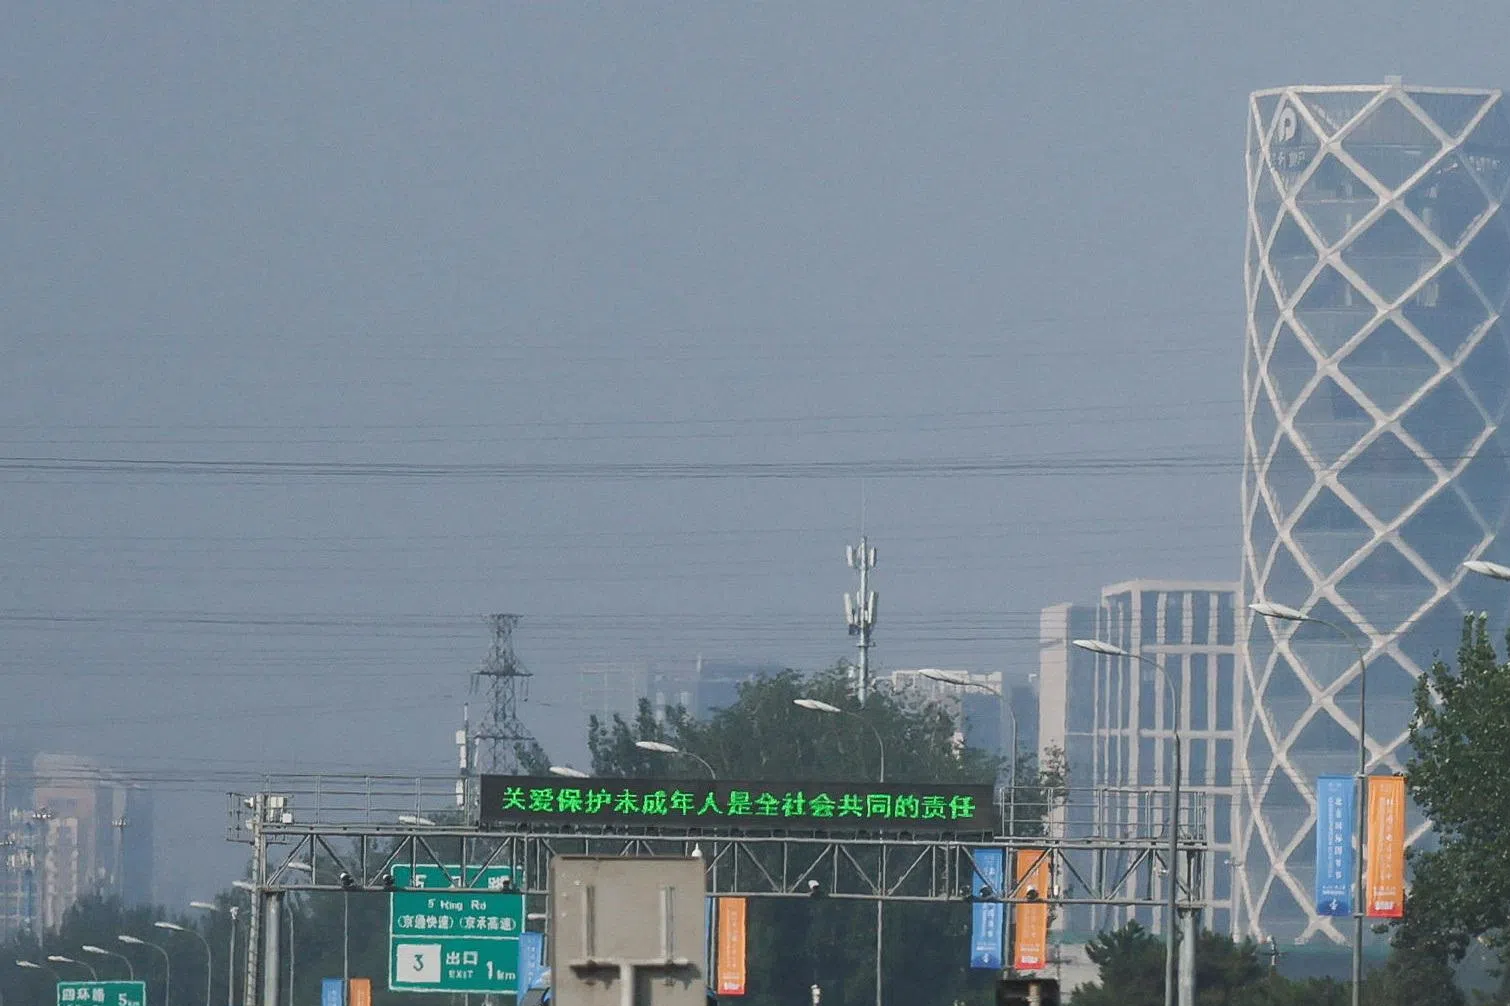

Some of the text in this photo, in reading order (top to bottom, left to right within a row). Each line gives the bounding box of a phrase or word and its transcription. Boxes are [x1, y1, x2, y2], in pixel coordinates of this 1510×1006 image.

[503, 786, 976, 819] 关爱保护未成年人是全社会共同的责任
[413, 954, 424, 971] 3
[446, 952, 478, 965] 出口
